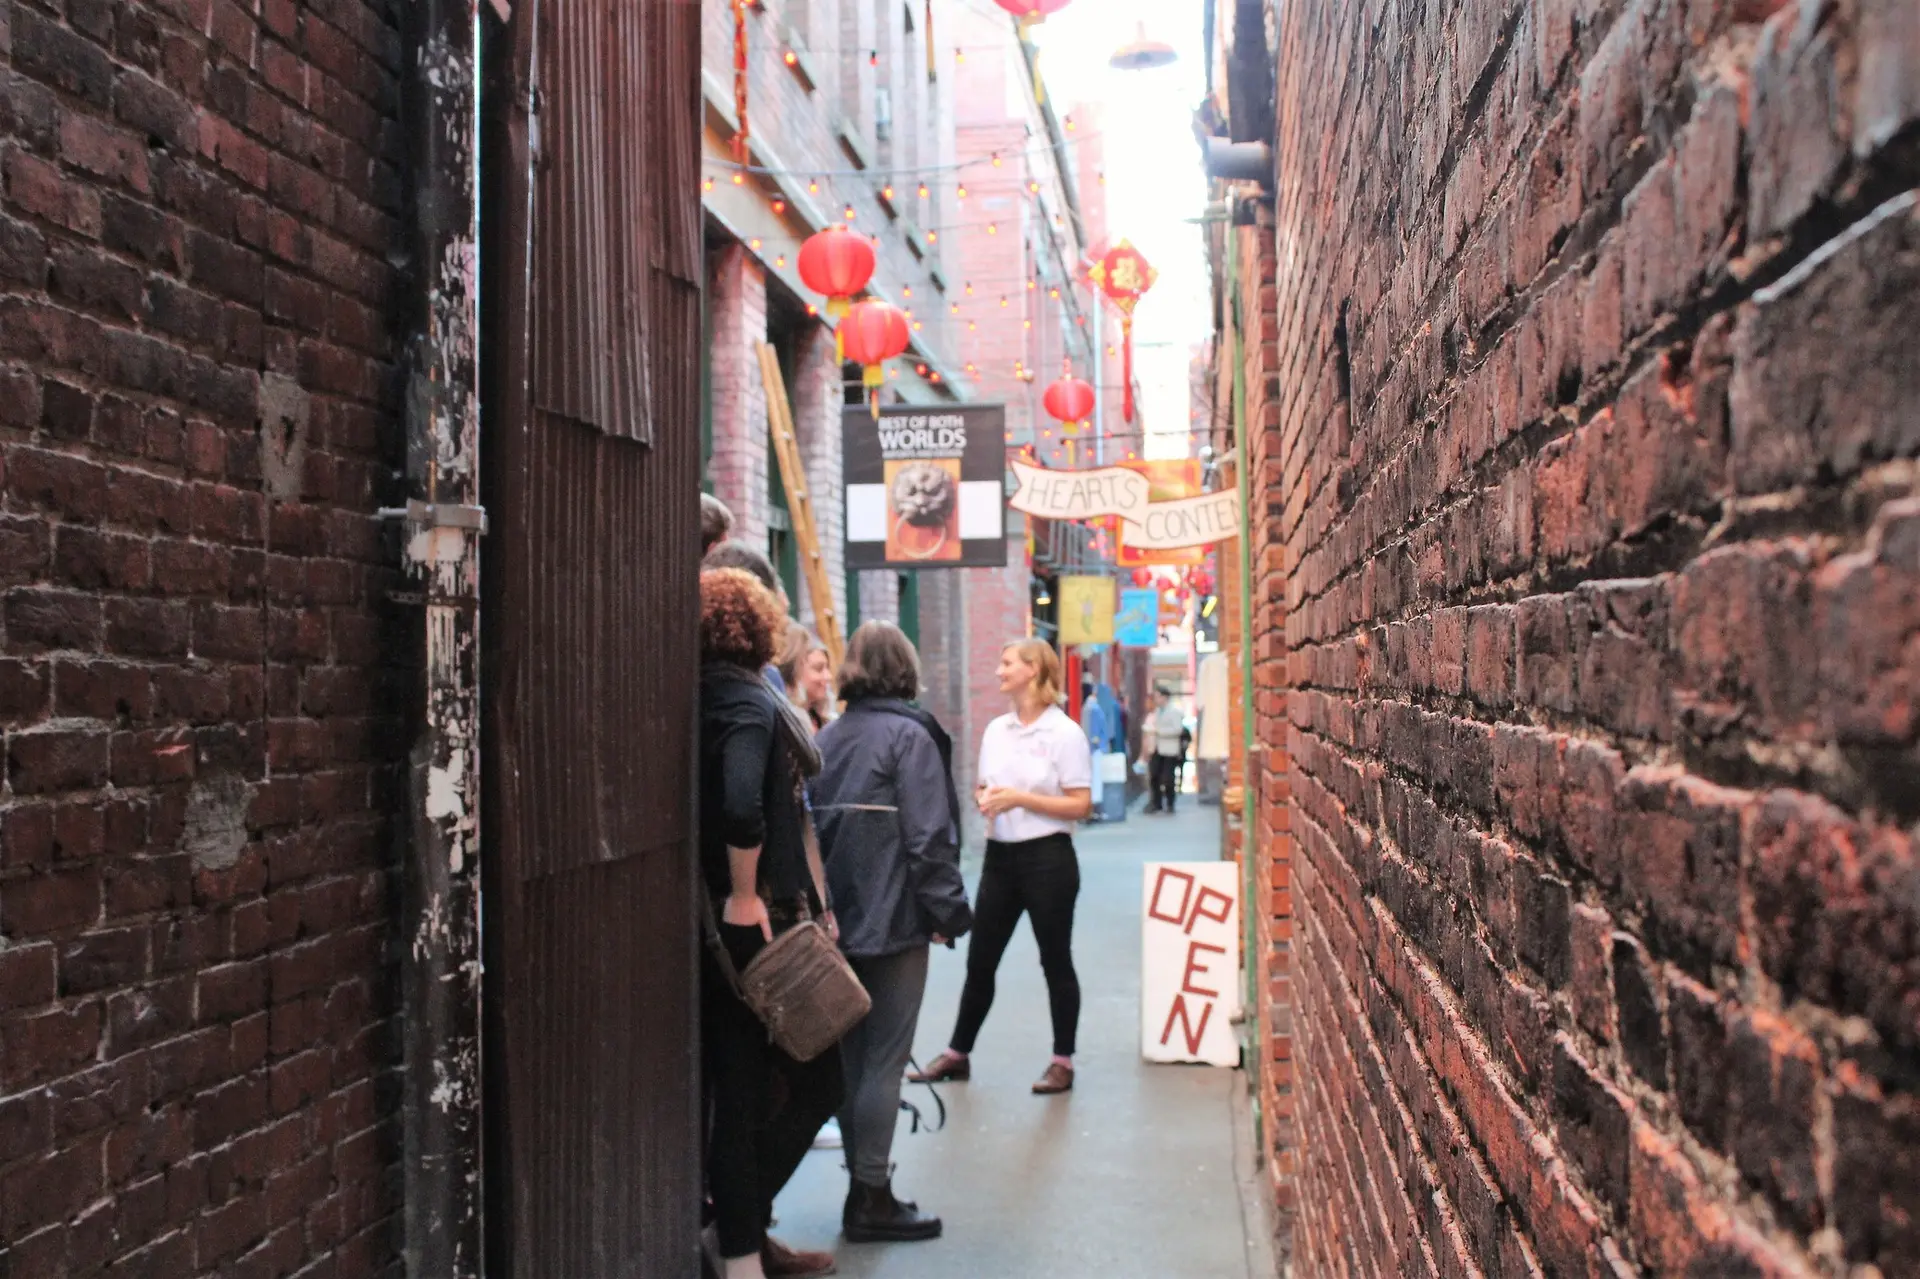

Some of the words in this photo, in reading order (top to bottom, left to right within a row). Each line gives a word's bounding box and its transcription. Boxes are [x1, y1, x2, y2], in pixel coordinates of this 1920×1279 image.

[909, 415, 927, 429] OF
[878, 428, 967, 450] WORLDS
[1148, 867, 1234, 1056] OPEN
